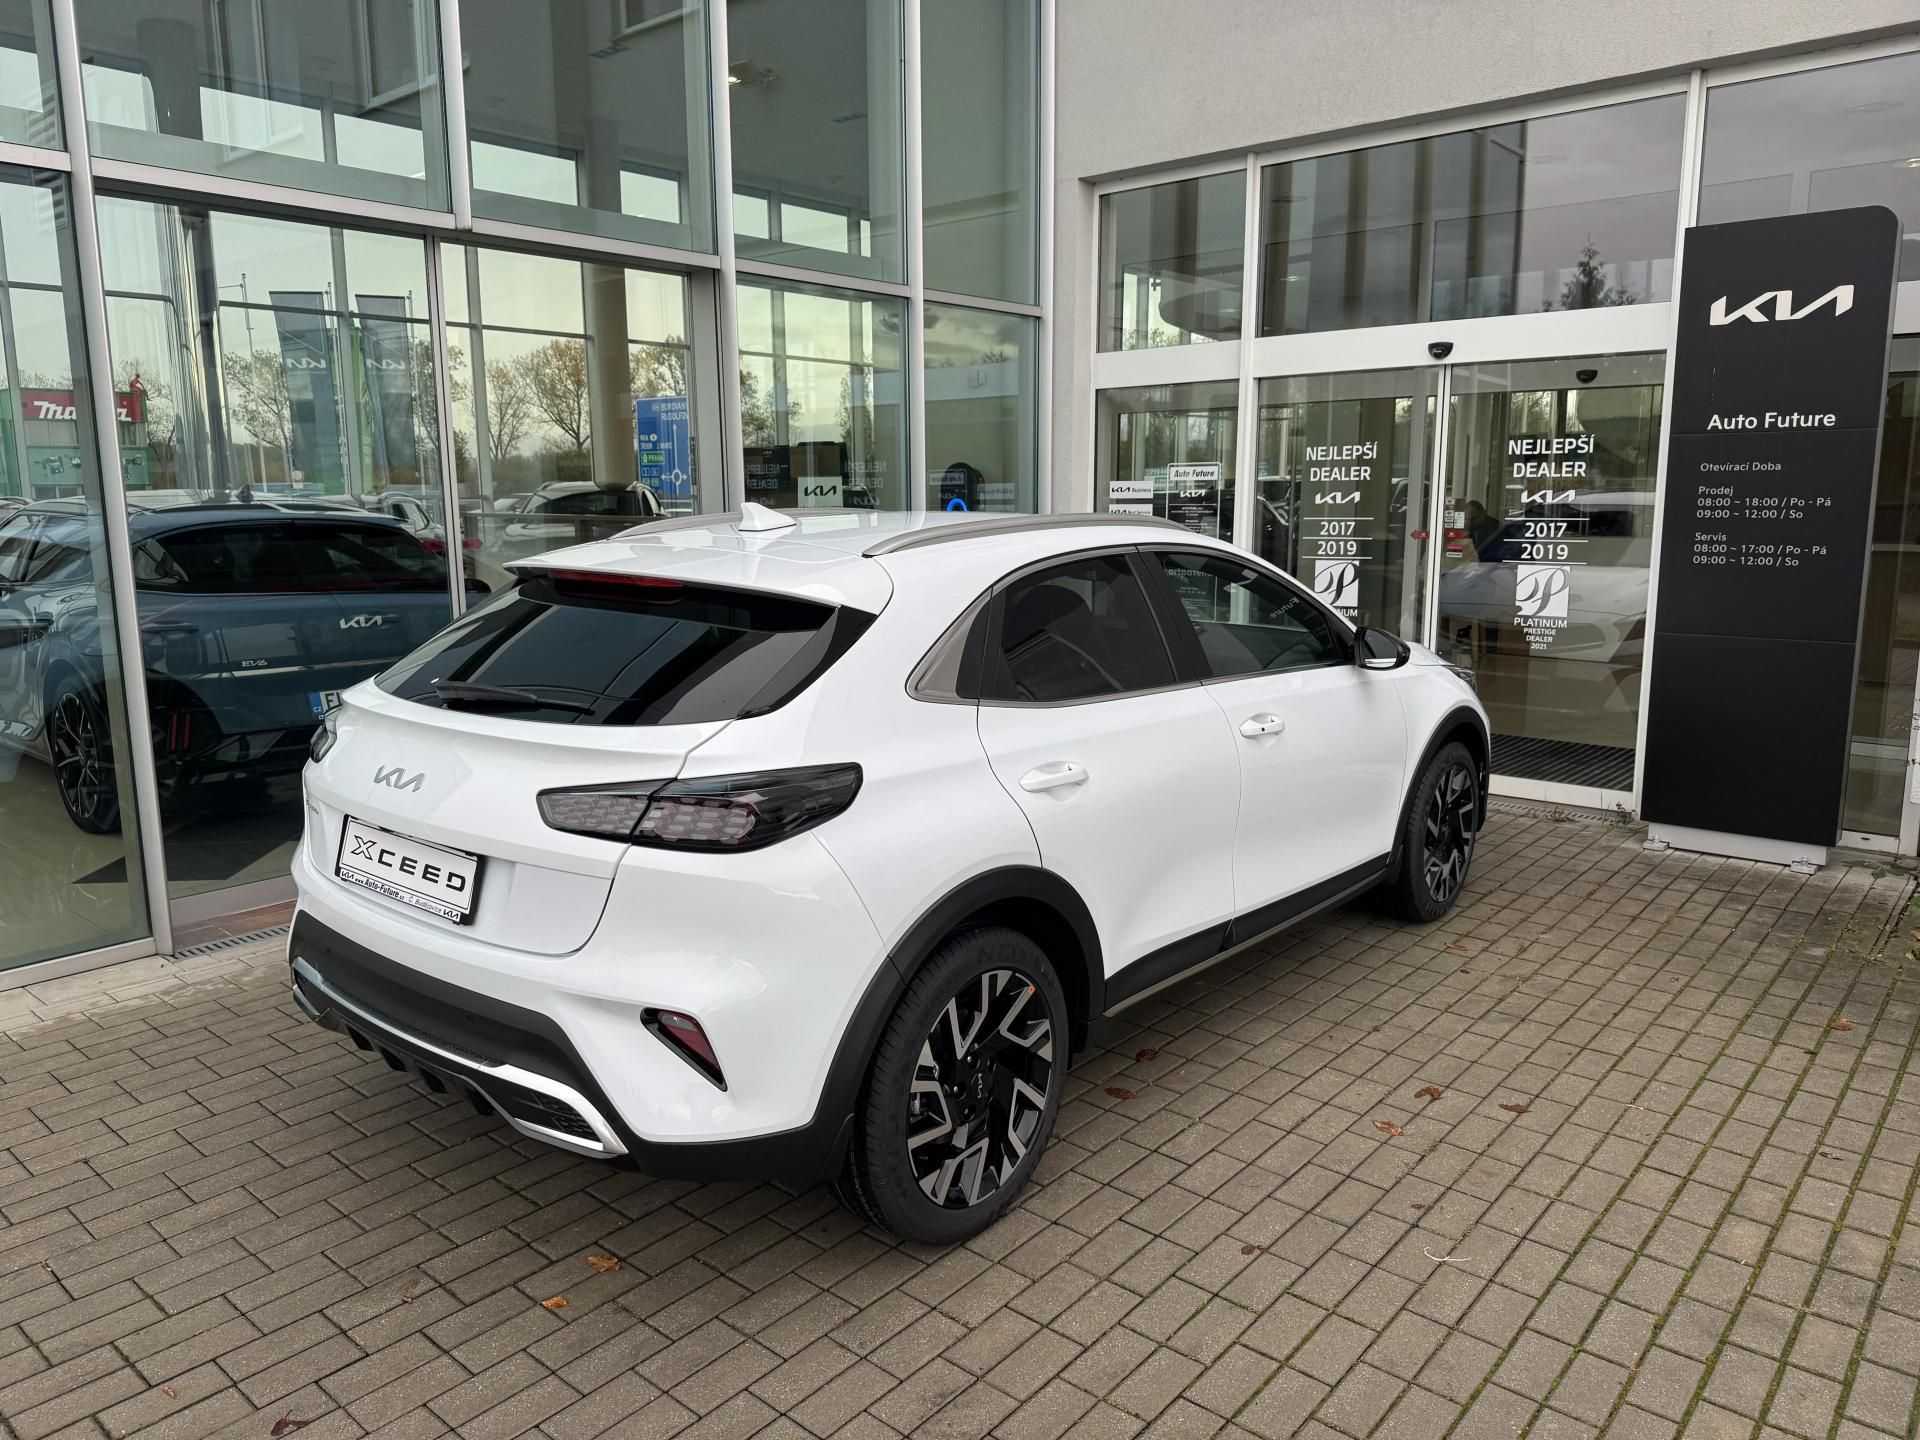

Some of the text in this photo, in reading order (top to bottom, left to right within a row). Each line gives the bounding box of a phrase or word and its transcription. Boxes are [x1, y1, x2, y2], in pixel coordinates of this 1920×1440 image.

[1709, 284, 1854, 326] KIA
[1707, 411, 1836, 430] Auto Future
[1306, 441, 1378, 461] NEJLEPŠÍ
[1508, 433, 1595, 456] NEJLEPŠÍ
[1174, 469, 1191, 478] Auto
[1192, 469, 1215, 478] Future
[1513, 461, 1587, 478] DEALER
[1700, 461, 1782, 472] Otevírací Doba
[1310, 466, 1371, 482] DEALER
[804, 485, 837, 497] KIA
[1315, 491, 1361, 505] KIA
[1521, 489, 1575, 503] KIA
[1698, 485, 1734, 497] Prodej
[1697, 497, 1731, 507] 08:00
[1745, 497, 1779, 507] 18:00
[1790, 498, 1805, 507] Po
[1816, 497, 1832, 507] Pá
[1696, 509, 1730, 519] 09:00
[1744, 509, 1778, 519] 12:00
[1789, 510, 1803, 519] So
[1319, 521, 1356, 536] 2017
[1524, 522, 1568, 538] 2017
[1695, 532, 1727, 541] Servis
[1317, 541, 1357, 555] 2019
[1520, 543, 1569, 560] 2019
[1693, 544, 1727, 553] 08:00
[1741, 544, 1774, 554] 17:00
[1786, 545, 1801, 554] Po
[1812, 545, 1827, 555] Pá
[1692, 555, 1726, 565] 09:00
[1740, 556, 1773, 565] 12:00
[1785, 557, 1799, 566] So
[339, 615, 383, 629] KIA
[1514, 617, 1568, 629] PLATINUM
[1523, 627, 1556, 636] PRESTIGE
[1526, 635, 1553, 643] DEALER
[1531, 642, 1547, 650] 2021
[241, 660, 268, 668] EV6
[373, 765, 425, 793] KIA
[350, 834, 467, 892] XCEED
[341, 870, 354, 880] KIA
[443, 908, 460, 920] KIA
